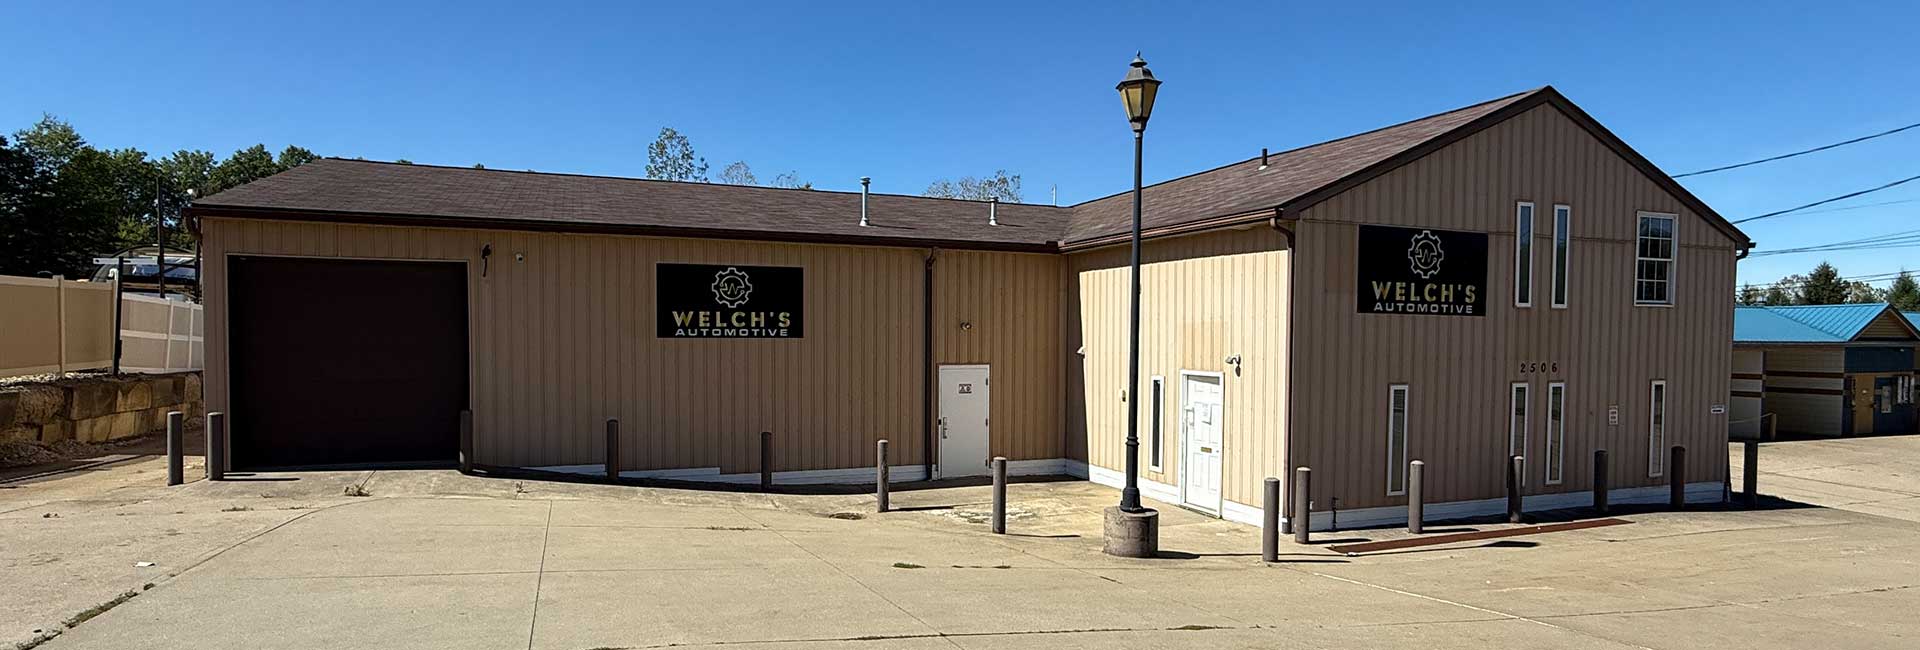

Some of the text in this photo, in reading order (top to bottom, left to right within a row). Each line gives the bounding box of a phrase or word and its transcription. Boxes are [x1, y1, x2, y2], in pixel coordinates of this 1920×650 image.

[1371, 281, 1476, 303] WELCH'S
[1374, 302, 1473, 314] AUTOMOTIVE
[672, 311, 790, 327] WELCH'S
[675, 328, 788, 336] AUTOMOTIVE
[1520, 362, 1558, 373] 2506
